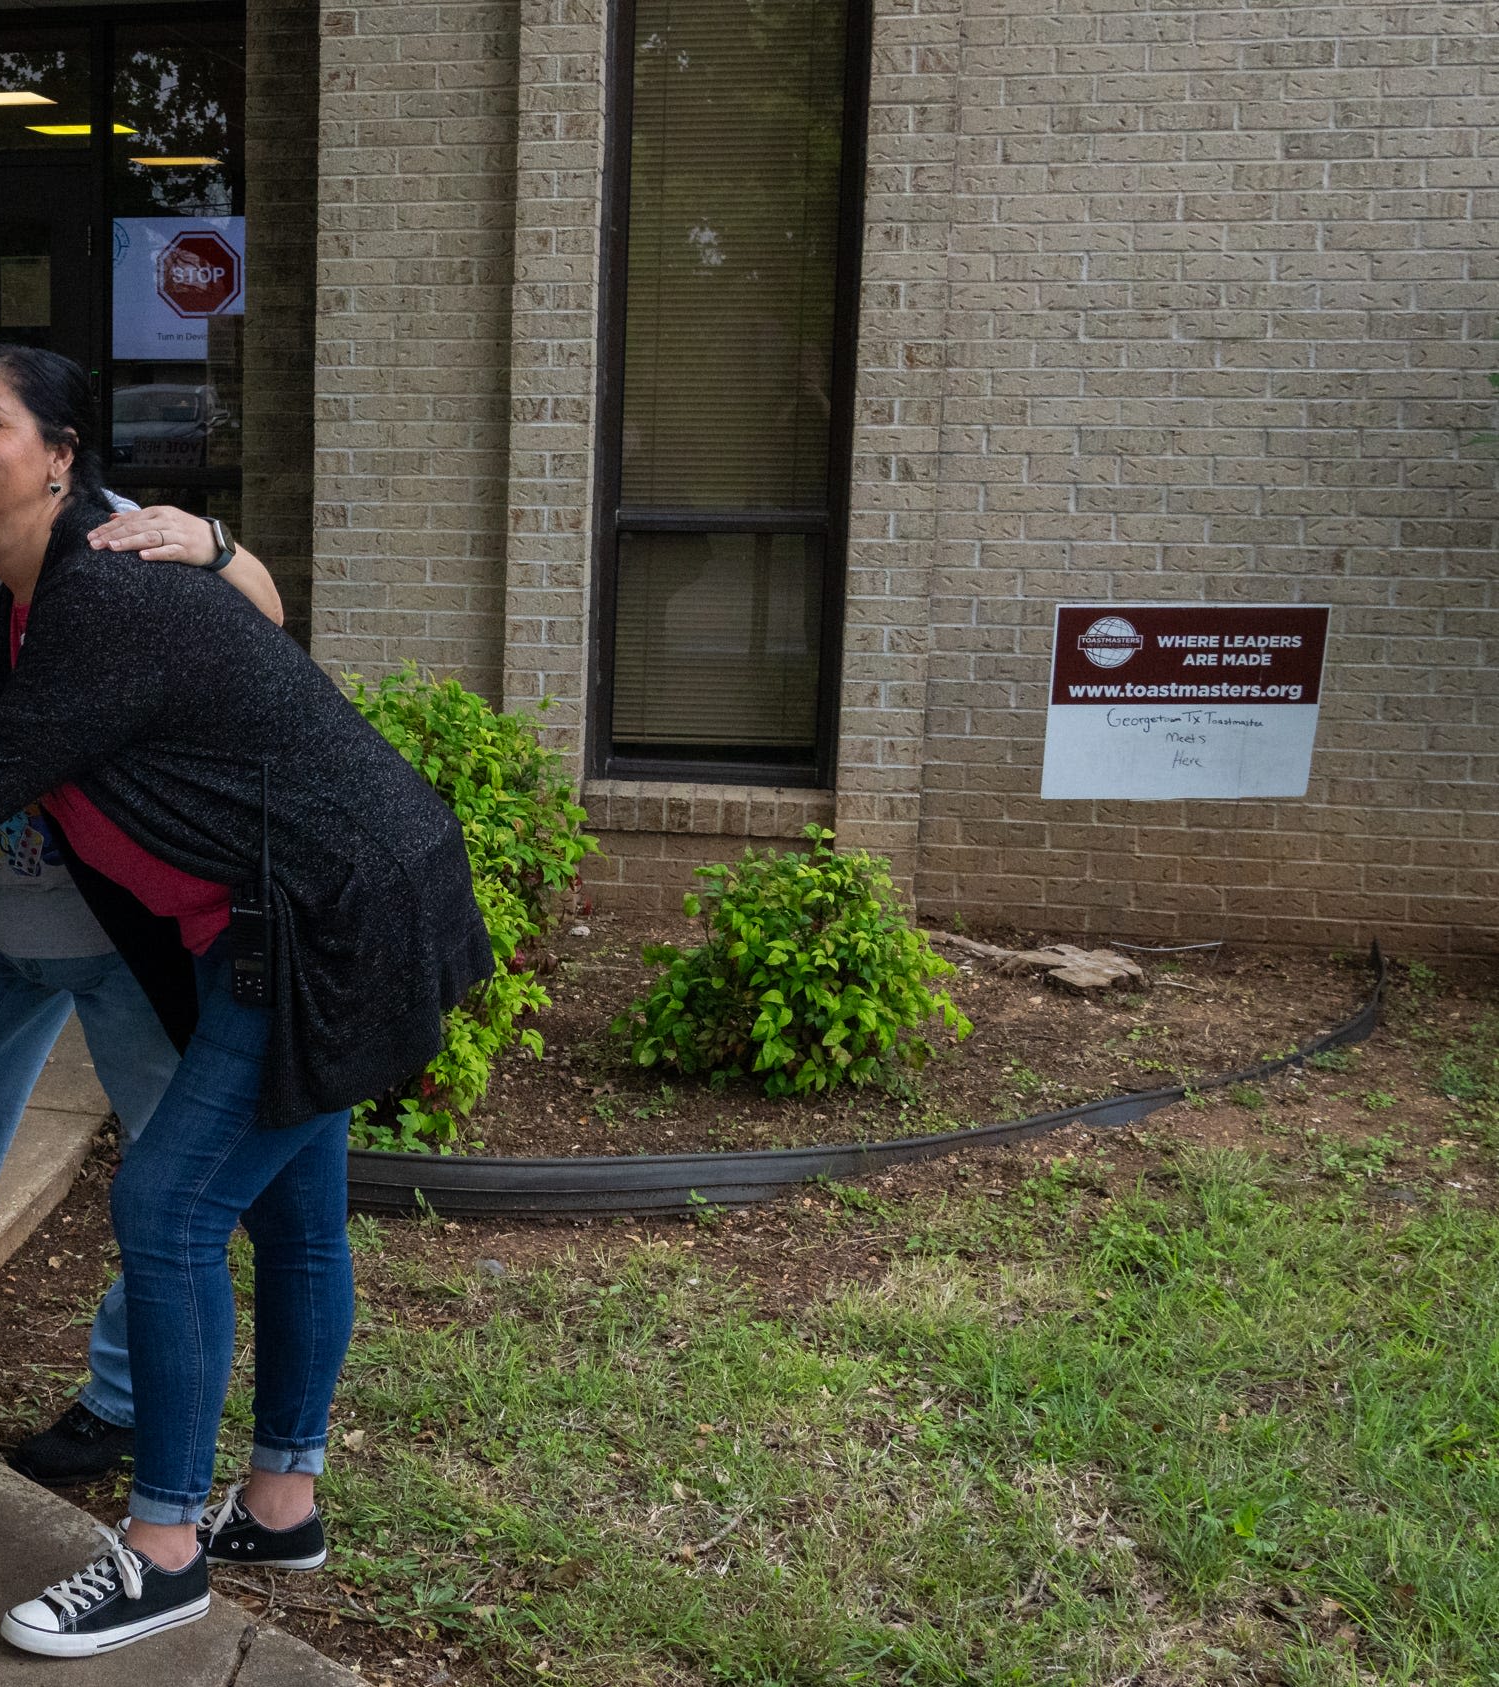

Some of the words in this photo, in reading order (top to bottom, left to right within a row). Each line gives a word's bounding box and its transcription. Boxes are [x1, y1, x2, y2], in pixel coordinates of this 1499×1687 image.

[172, 266, 226, 284] STOP
[1157, 635, 1220, 648] WHERE
[1223, 635, 1303, 649] LEADERS
[1182, 654, 1219, 666] ARE
[1222, 653, 1272, 666] MADE
[1068, 682, 1303, 700] www.toastmasters.org
